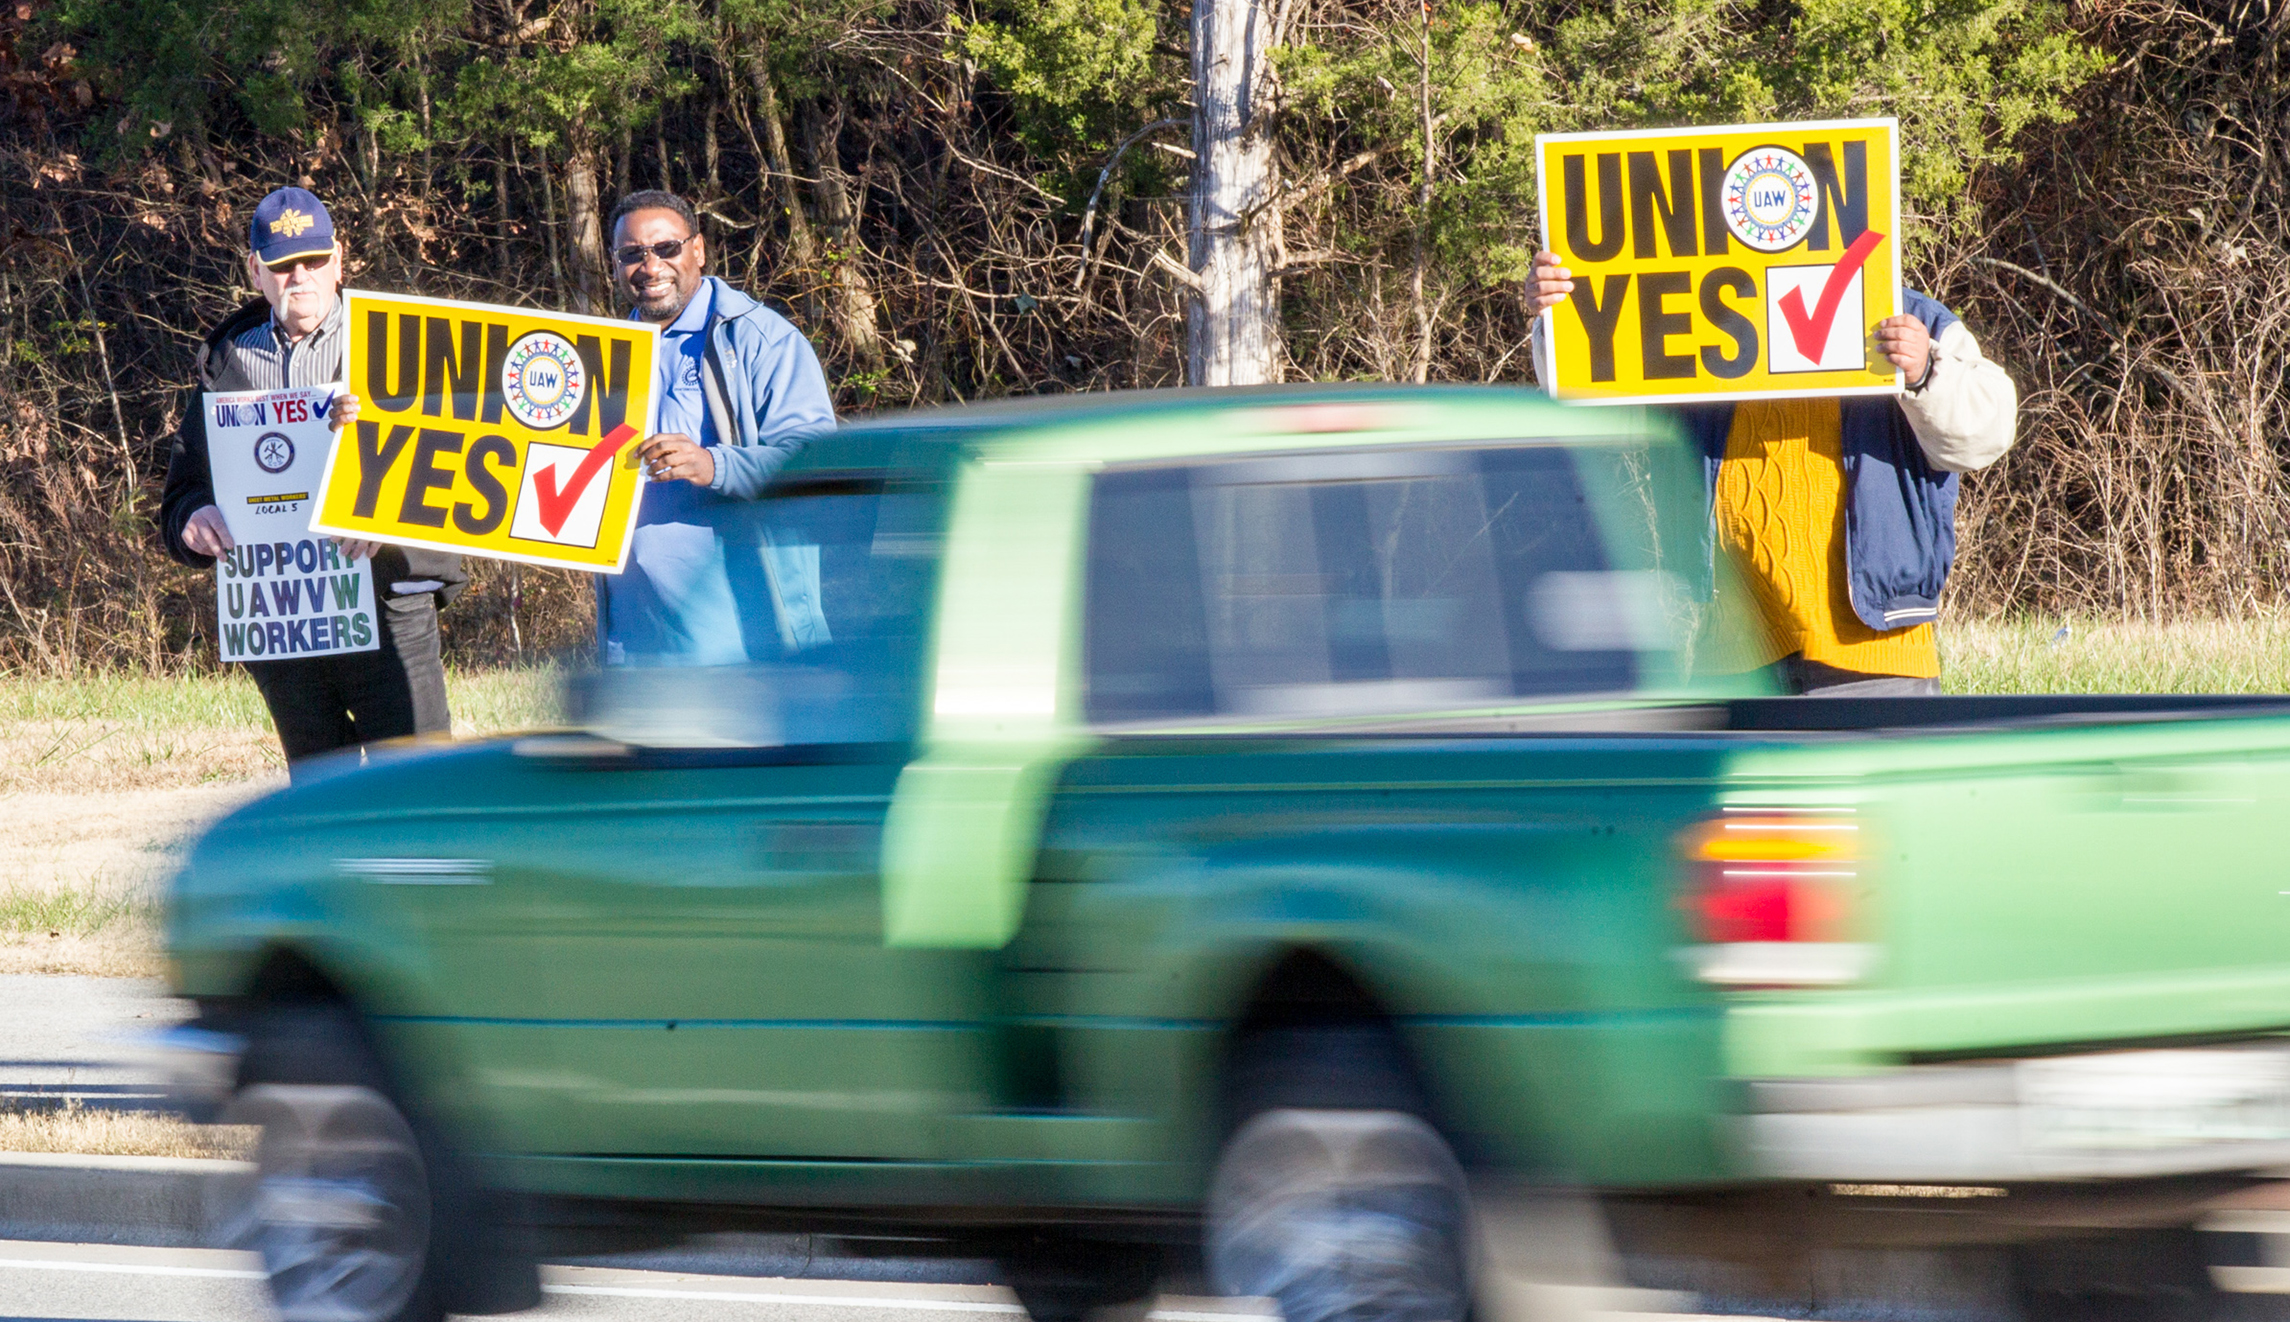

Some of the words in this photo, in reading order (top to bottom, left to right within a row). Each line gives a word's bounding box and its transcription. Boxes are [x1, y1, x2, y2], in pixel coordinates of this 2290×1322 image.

[1563, 140, 1869, 262] UNION
[1754, 190, 1786, 208] UAW
[1569, 267, 1759, 383] YES
[367, 310, 632, 438] UNION
[529, 371, 558, 389] UAW
[216, 403, 267, 428] UNION
[272, 399, 308, 424] YES
[352, 420, 517, 536] YES
[255, 504, 287, 515] LOCAL
[291, 502, 298, 512] 5
[223, 612, 372, 656] WORKERS
